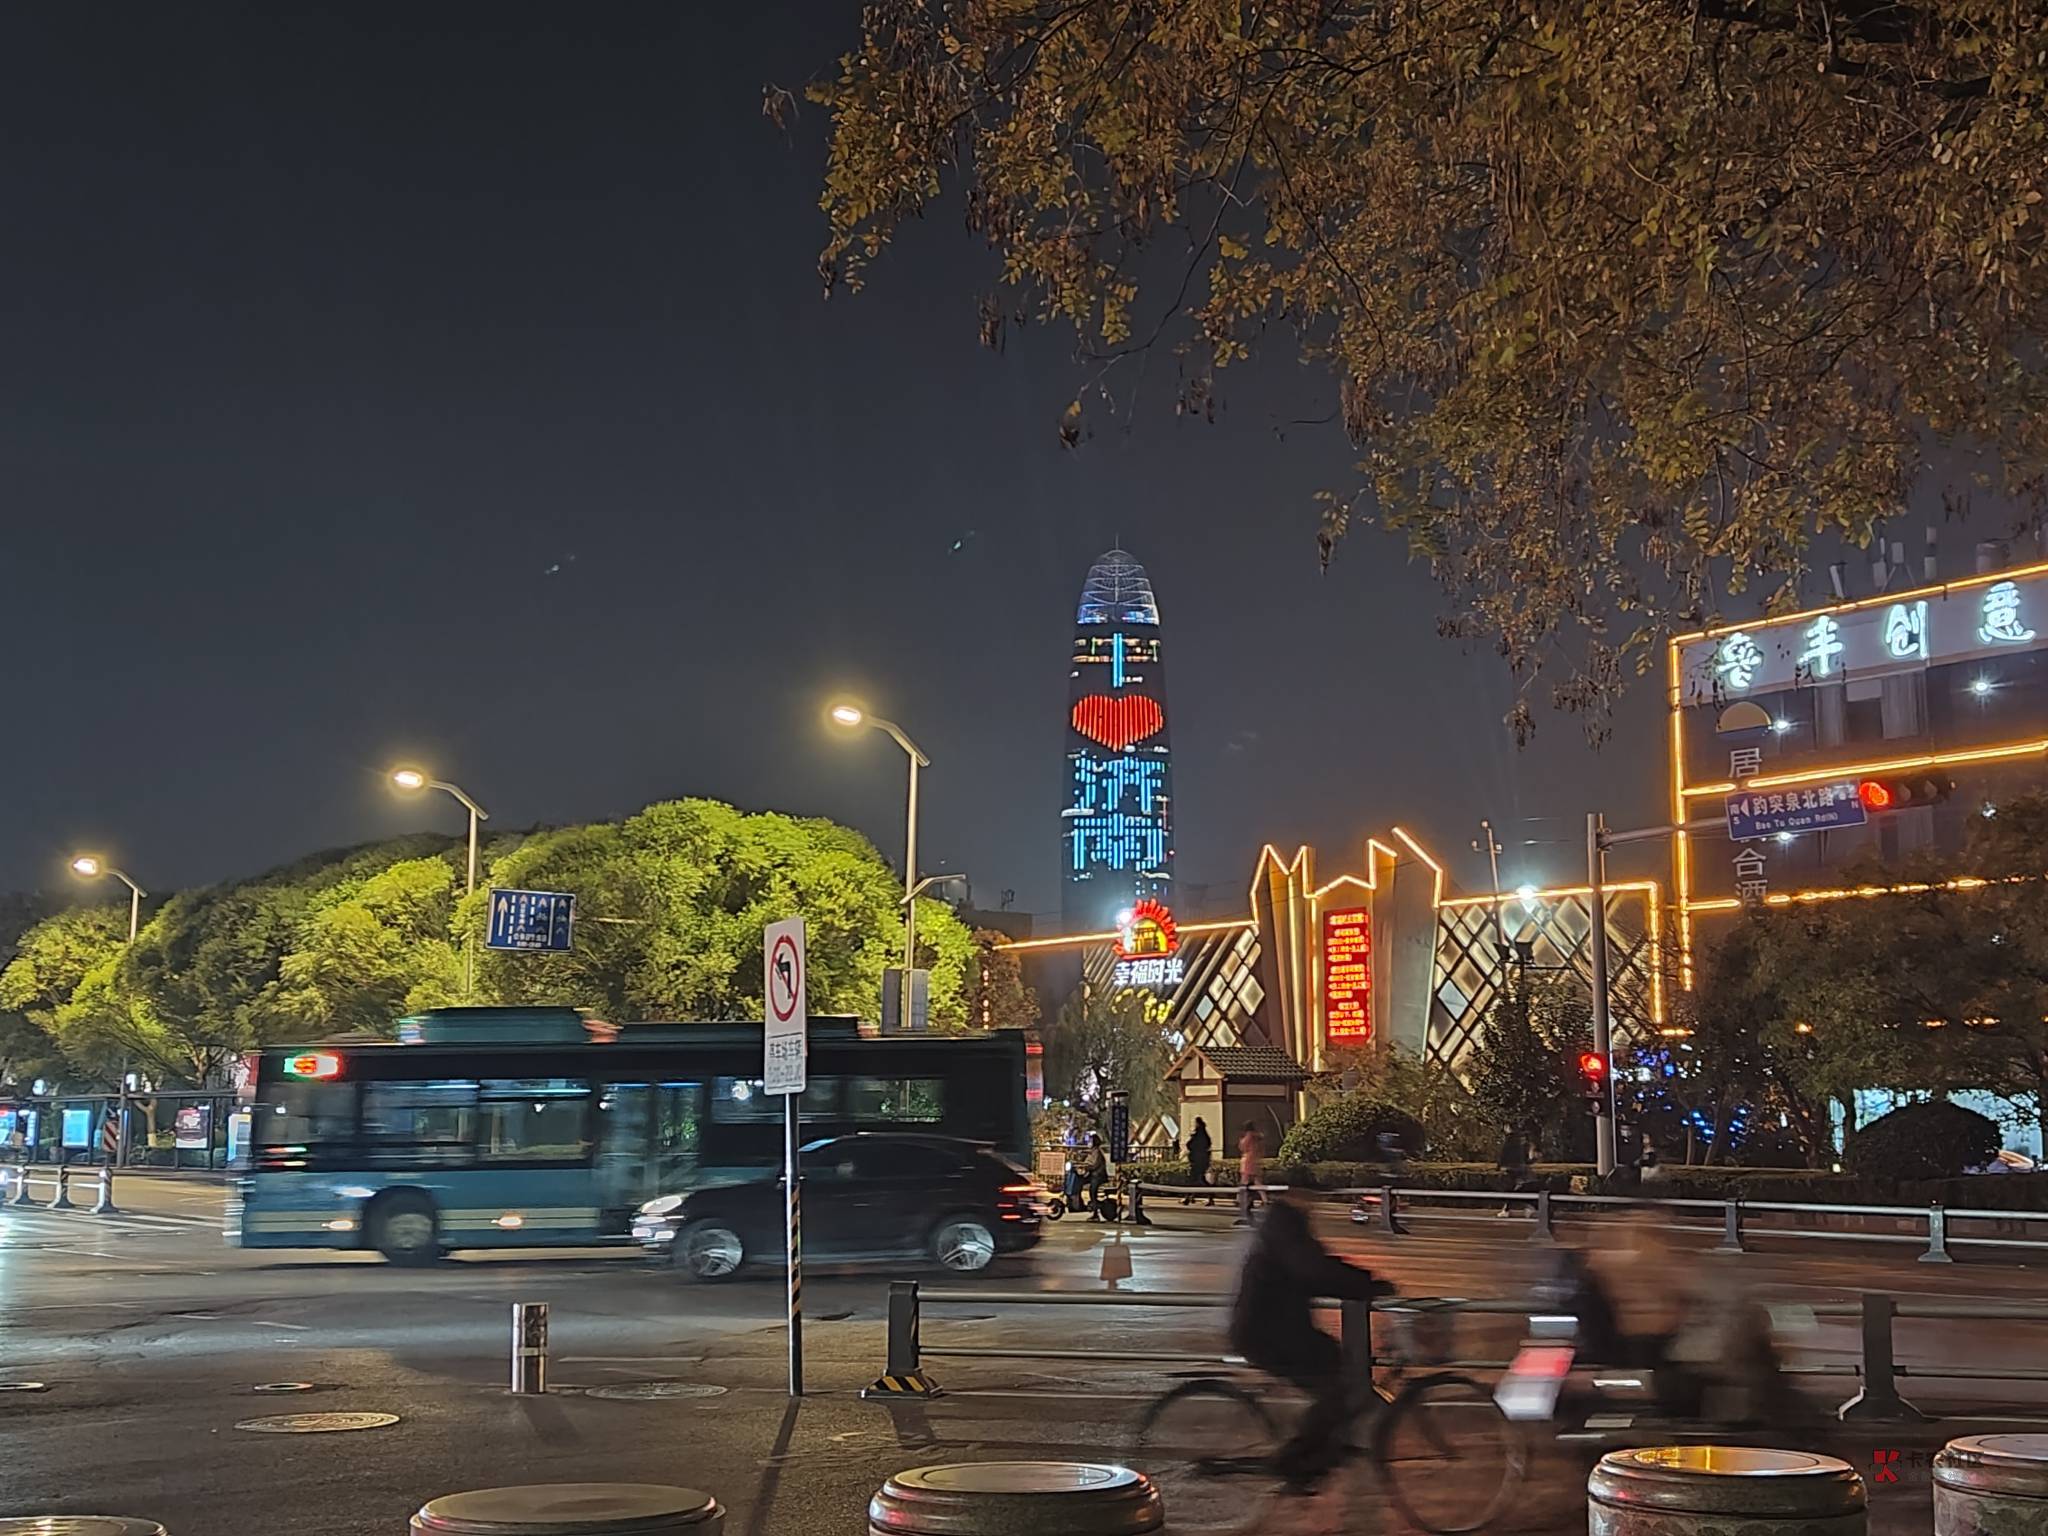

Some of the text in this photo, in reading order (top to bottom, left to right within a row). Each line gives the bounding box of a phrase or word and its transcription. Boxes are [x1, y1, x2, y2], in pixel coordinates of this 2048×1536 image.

[1752, 787, 1835, 816] 趵突泉北路
[1755, 821, 1772, 831] Bao
[1775, 818, 1786, 828] Tu
[1788, 815, 1811, 826] Quan
[1113, 958, 1184, 986] 幸福时光
